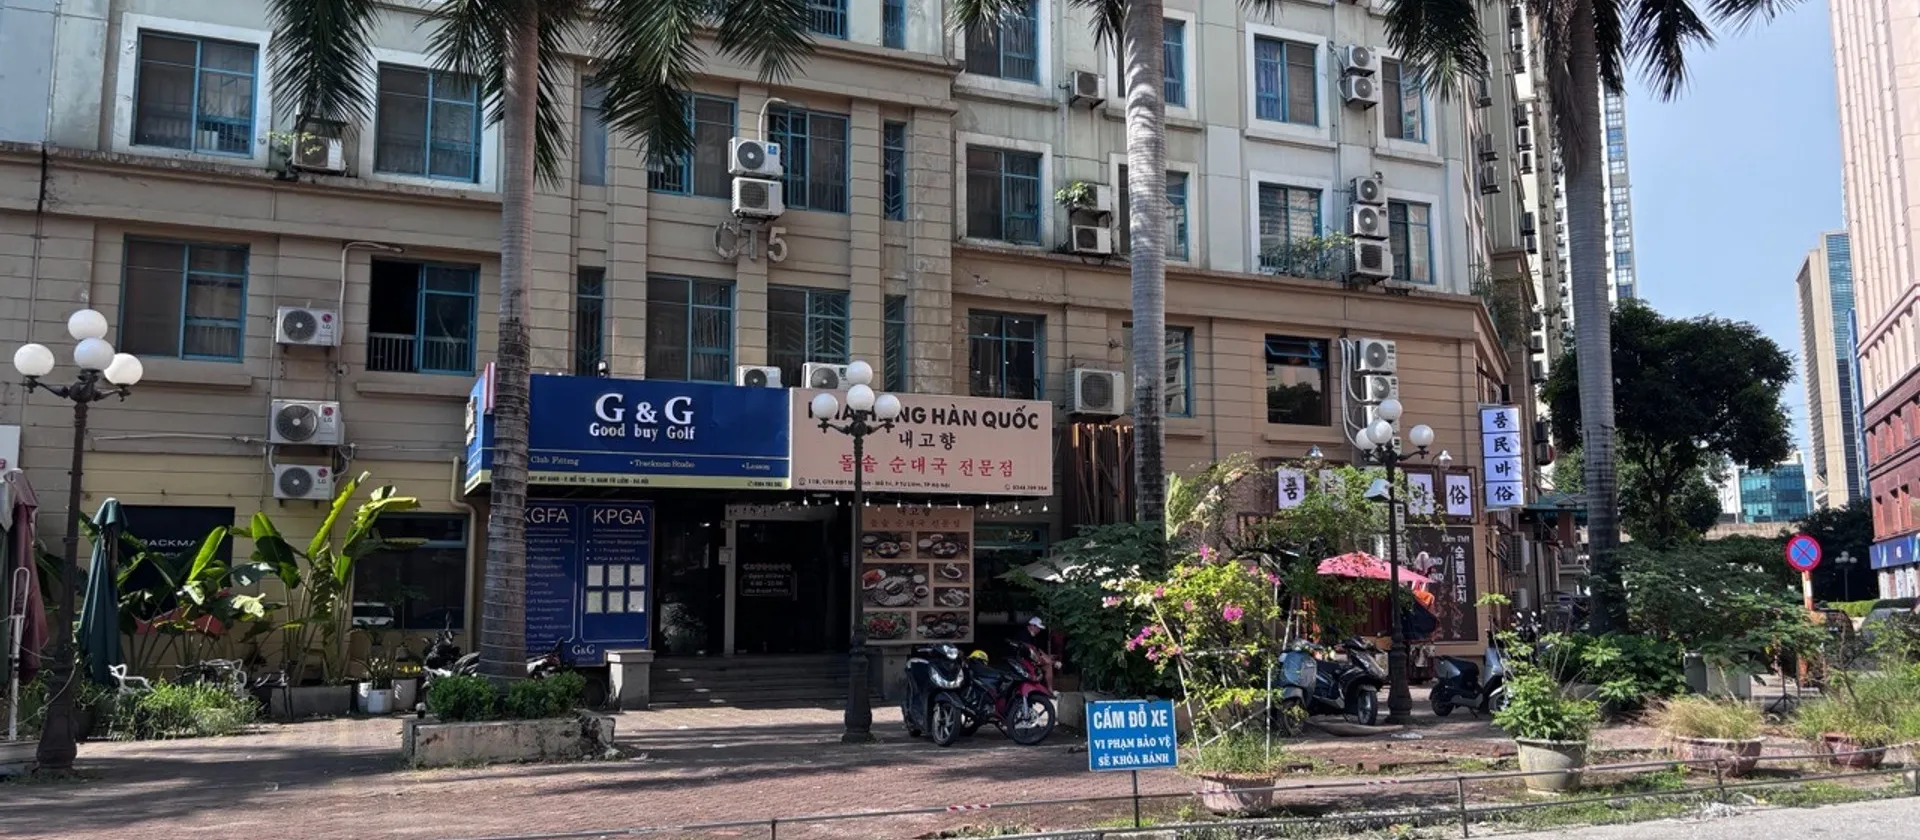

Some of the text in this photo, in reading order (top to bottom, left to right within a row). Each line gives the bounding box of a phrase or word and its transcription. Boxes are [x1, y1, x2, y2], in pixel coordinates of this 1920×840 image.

[713, 221, 788, 262] CT5
[595, 393, 694, 425] G & G
[932, 404, 977, 427] HÀN
[982, 405, 1038, 430] QUỐC
[589, 422, 695, 441] Good buy Golf
[899, 430, 956, 450] 내고향
[530, 456, 550, 464] Club
[746, 462, 770, 471] Lesson
[889, 456, 947, 476] 순대국
[959, 459, 1013, 478] 전문점
[1448, 483, 1470, 505] 俗
[593, 508, 645, 525] KPGA
[572, 644, 596, 655] G&G
[1093, 704, 1168, 729] CẤM ĐỖ XE
[1094, 734, 1171, 751] VI PHẠM BẢO VỆ
[1098, 753, 1111, 766] SẼ
[1142, 750, 1169, 764] BÁNH
